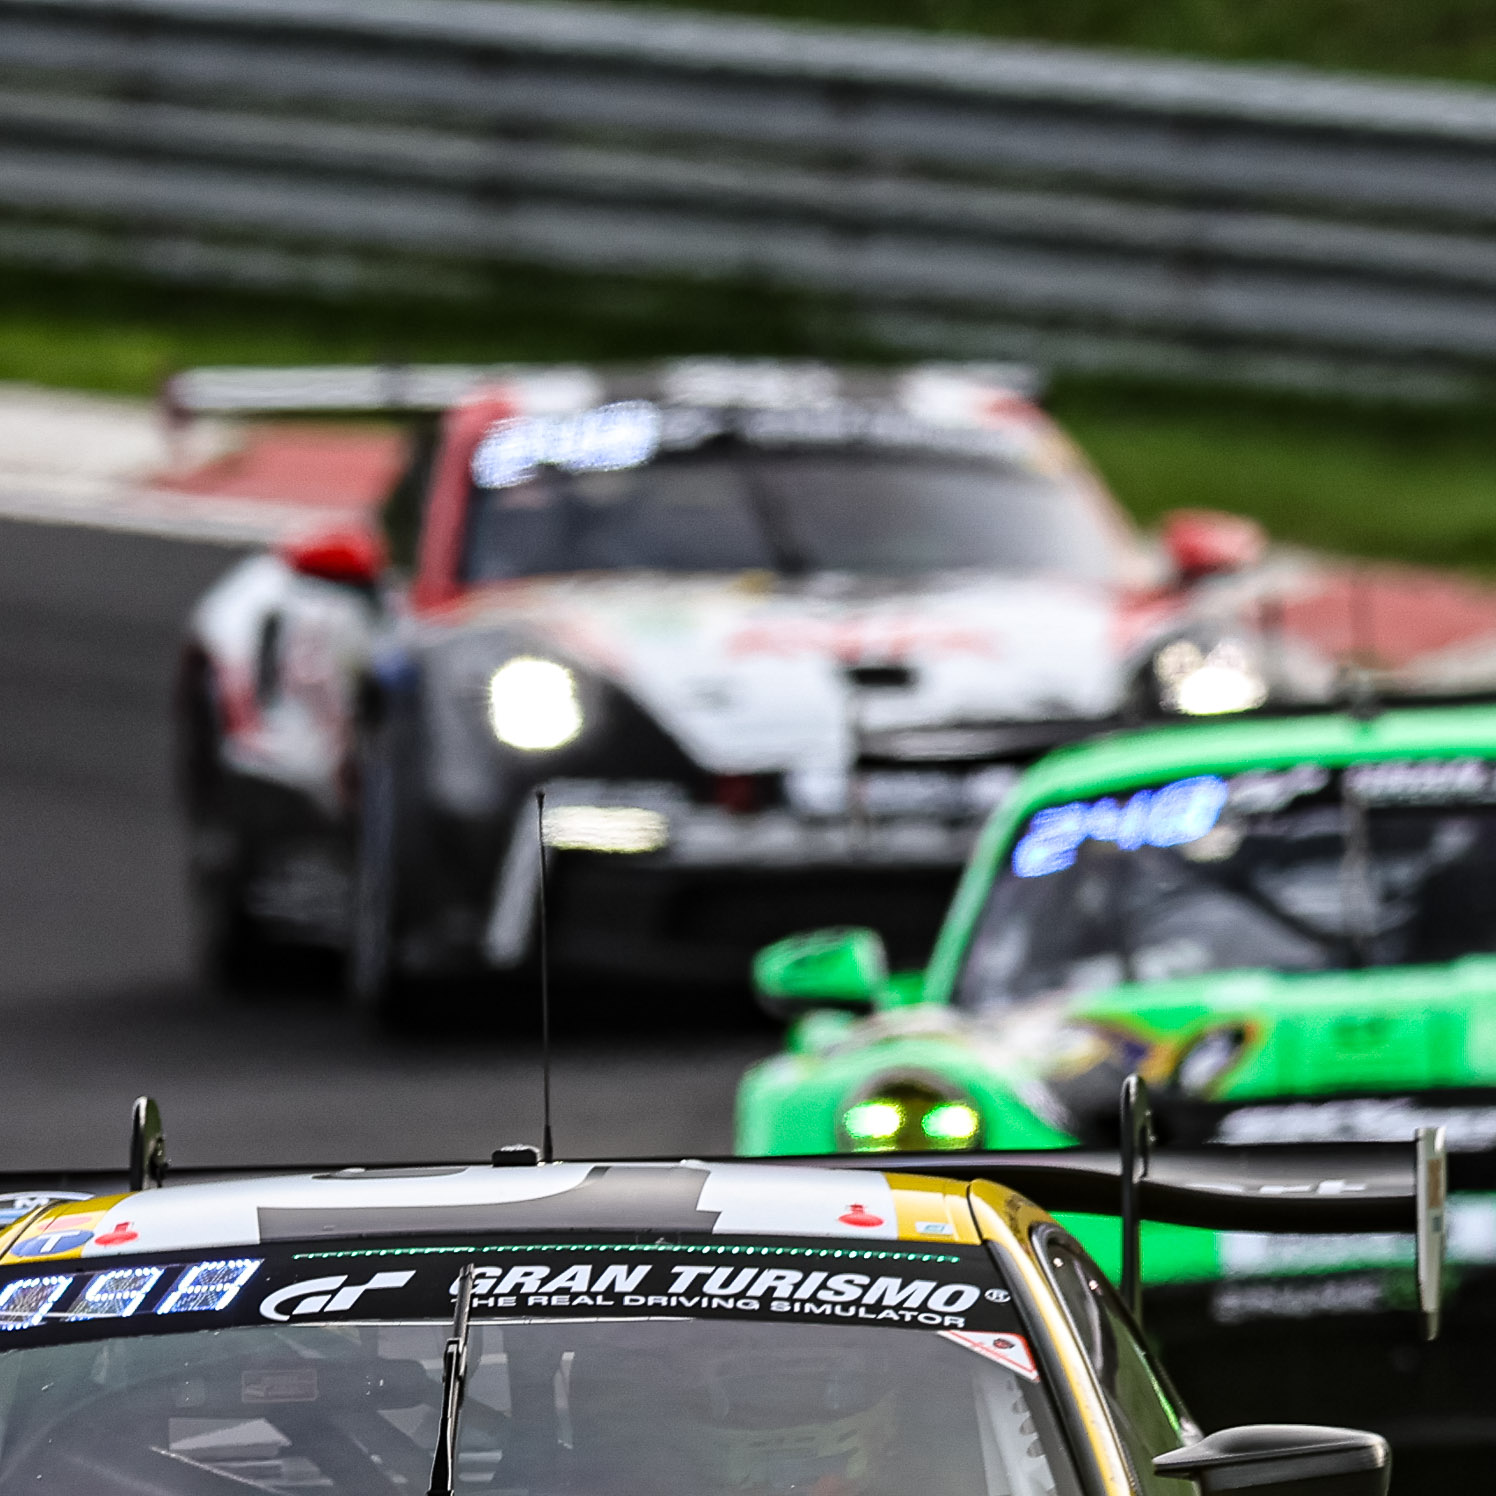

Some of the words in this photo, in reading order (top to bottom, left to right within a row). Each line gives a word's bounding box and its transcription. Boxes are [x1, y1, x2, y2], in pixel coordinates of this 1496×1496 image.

[449, 1263, 652, 1297] GRAN
[451, 1295, 517, 1308] HE
[527, 1295, 615, 1307] REAL
[623, 1295, 761, 1311] DRIVING
[769, 1300, 967, 1329] SIMULATOR
